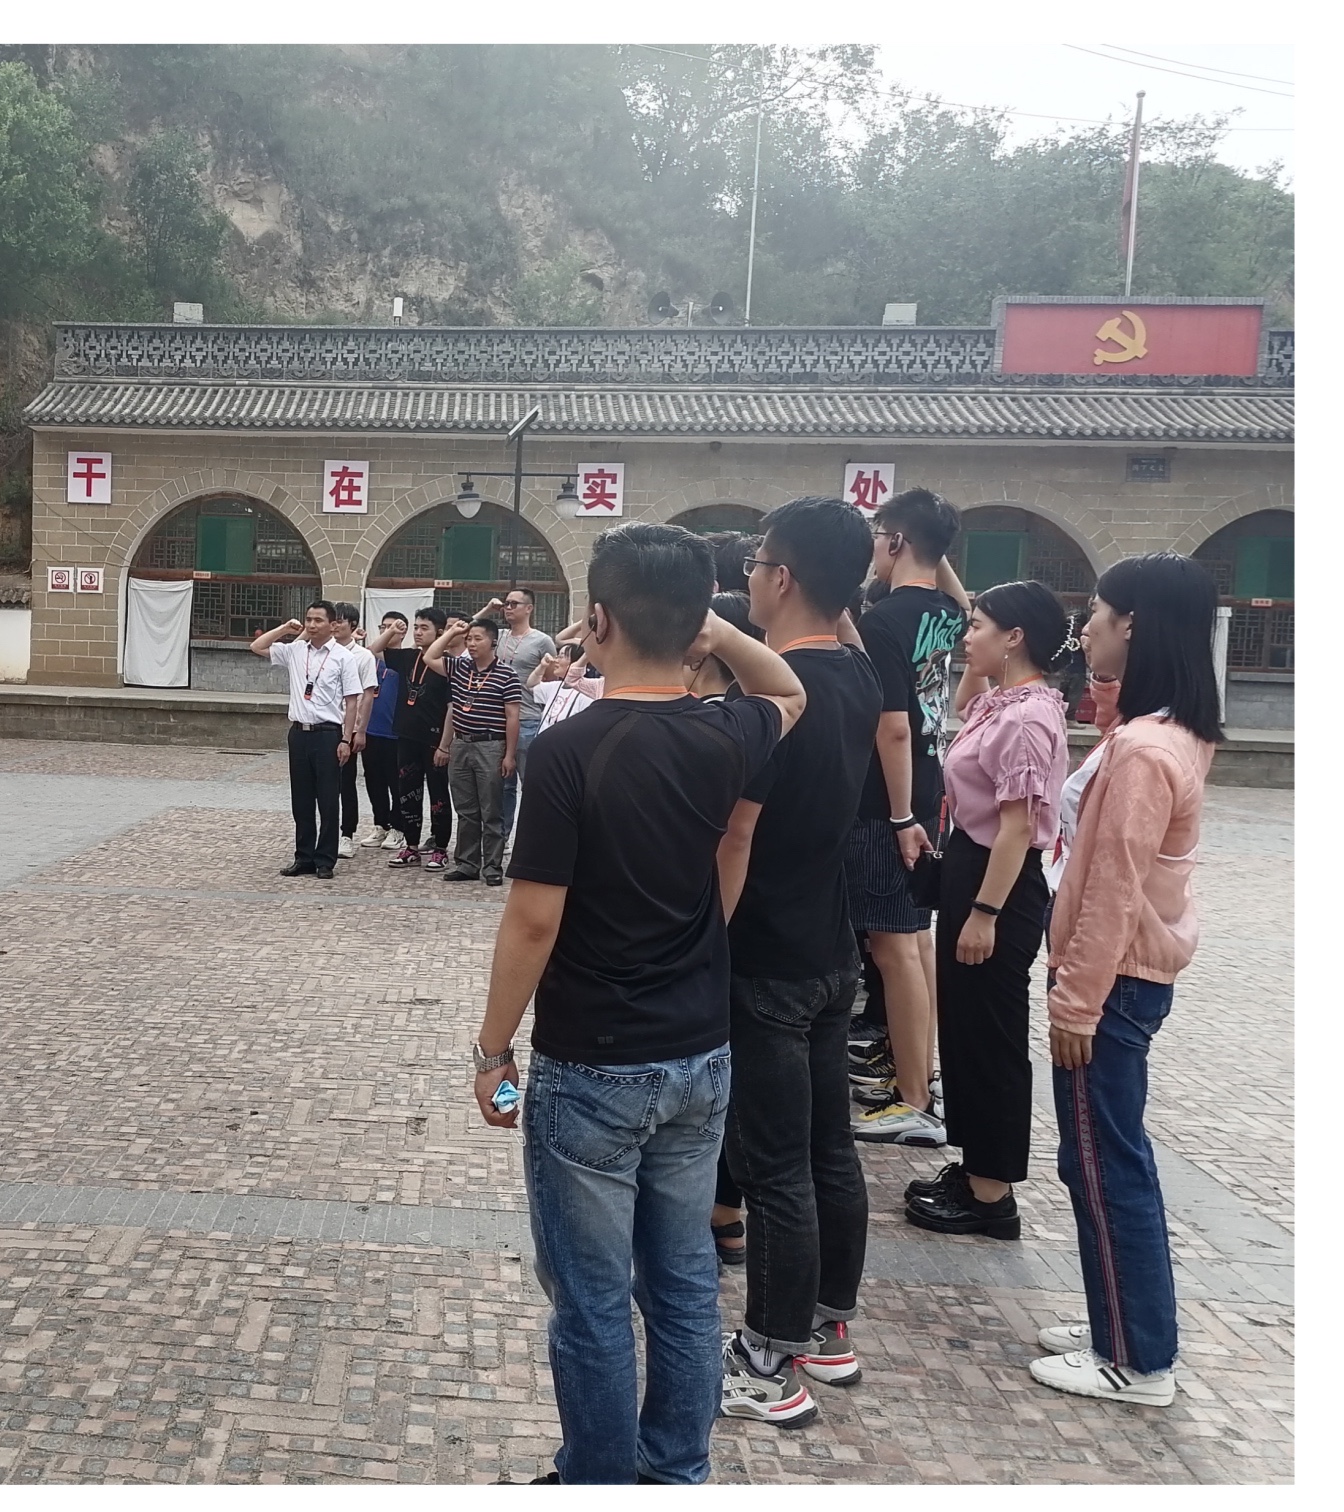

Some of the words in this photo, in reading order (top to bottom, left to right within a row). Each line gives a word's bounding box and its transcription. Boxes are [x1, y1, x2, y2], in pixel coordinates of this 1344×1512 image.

[72, 457, 106, 498] 干
[328, 465, 364, 508] 在
[582, 468, 618, 511] 实
[849, 469, 888, 510] 处
